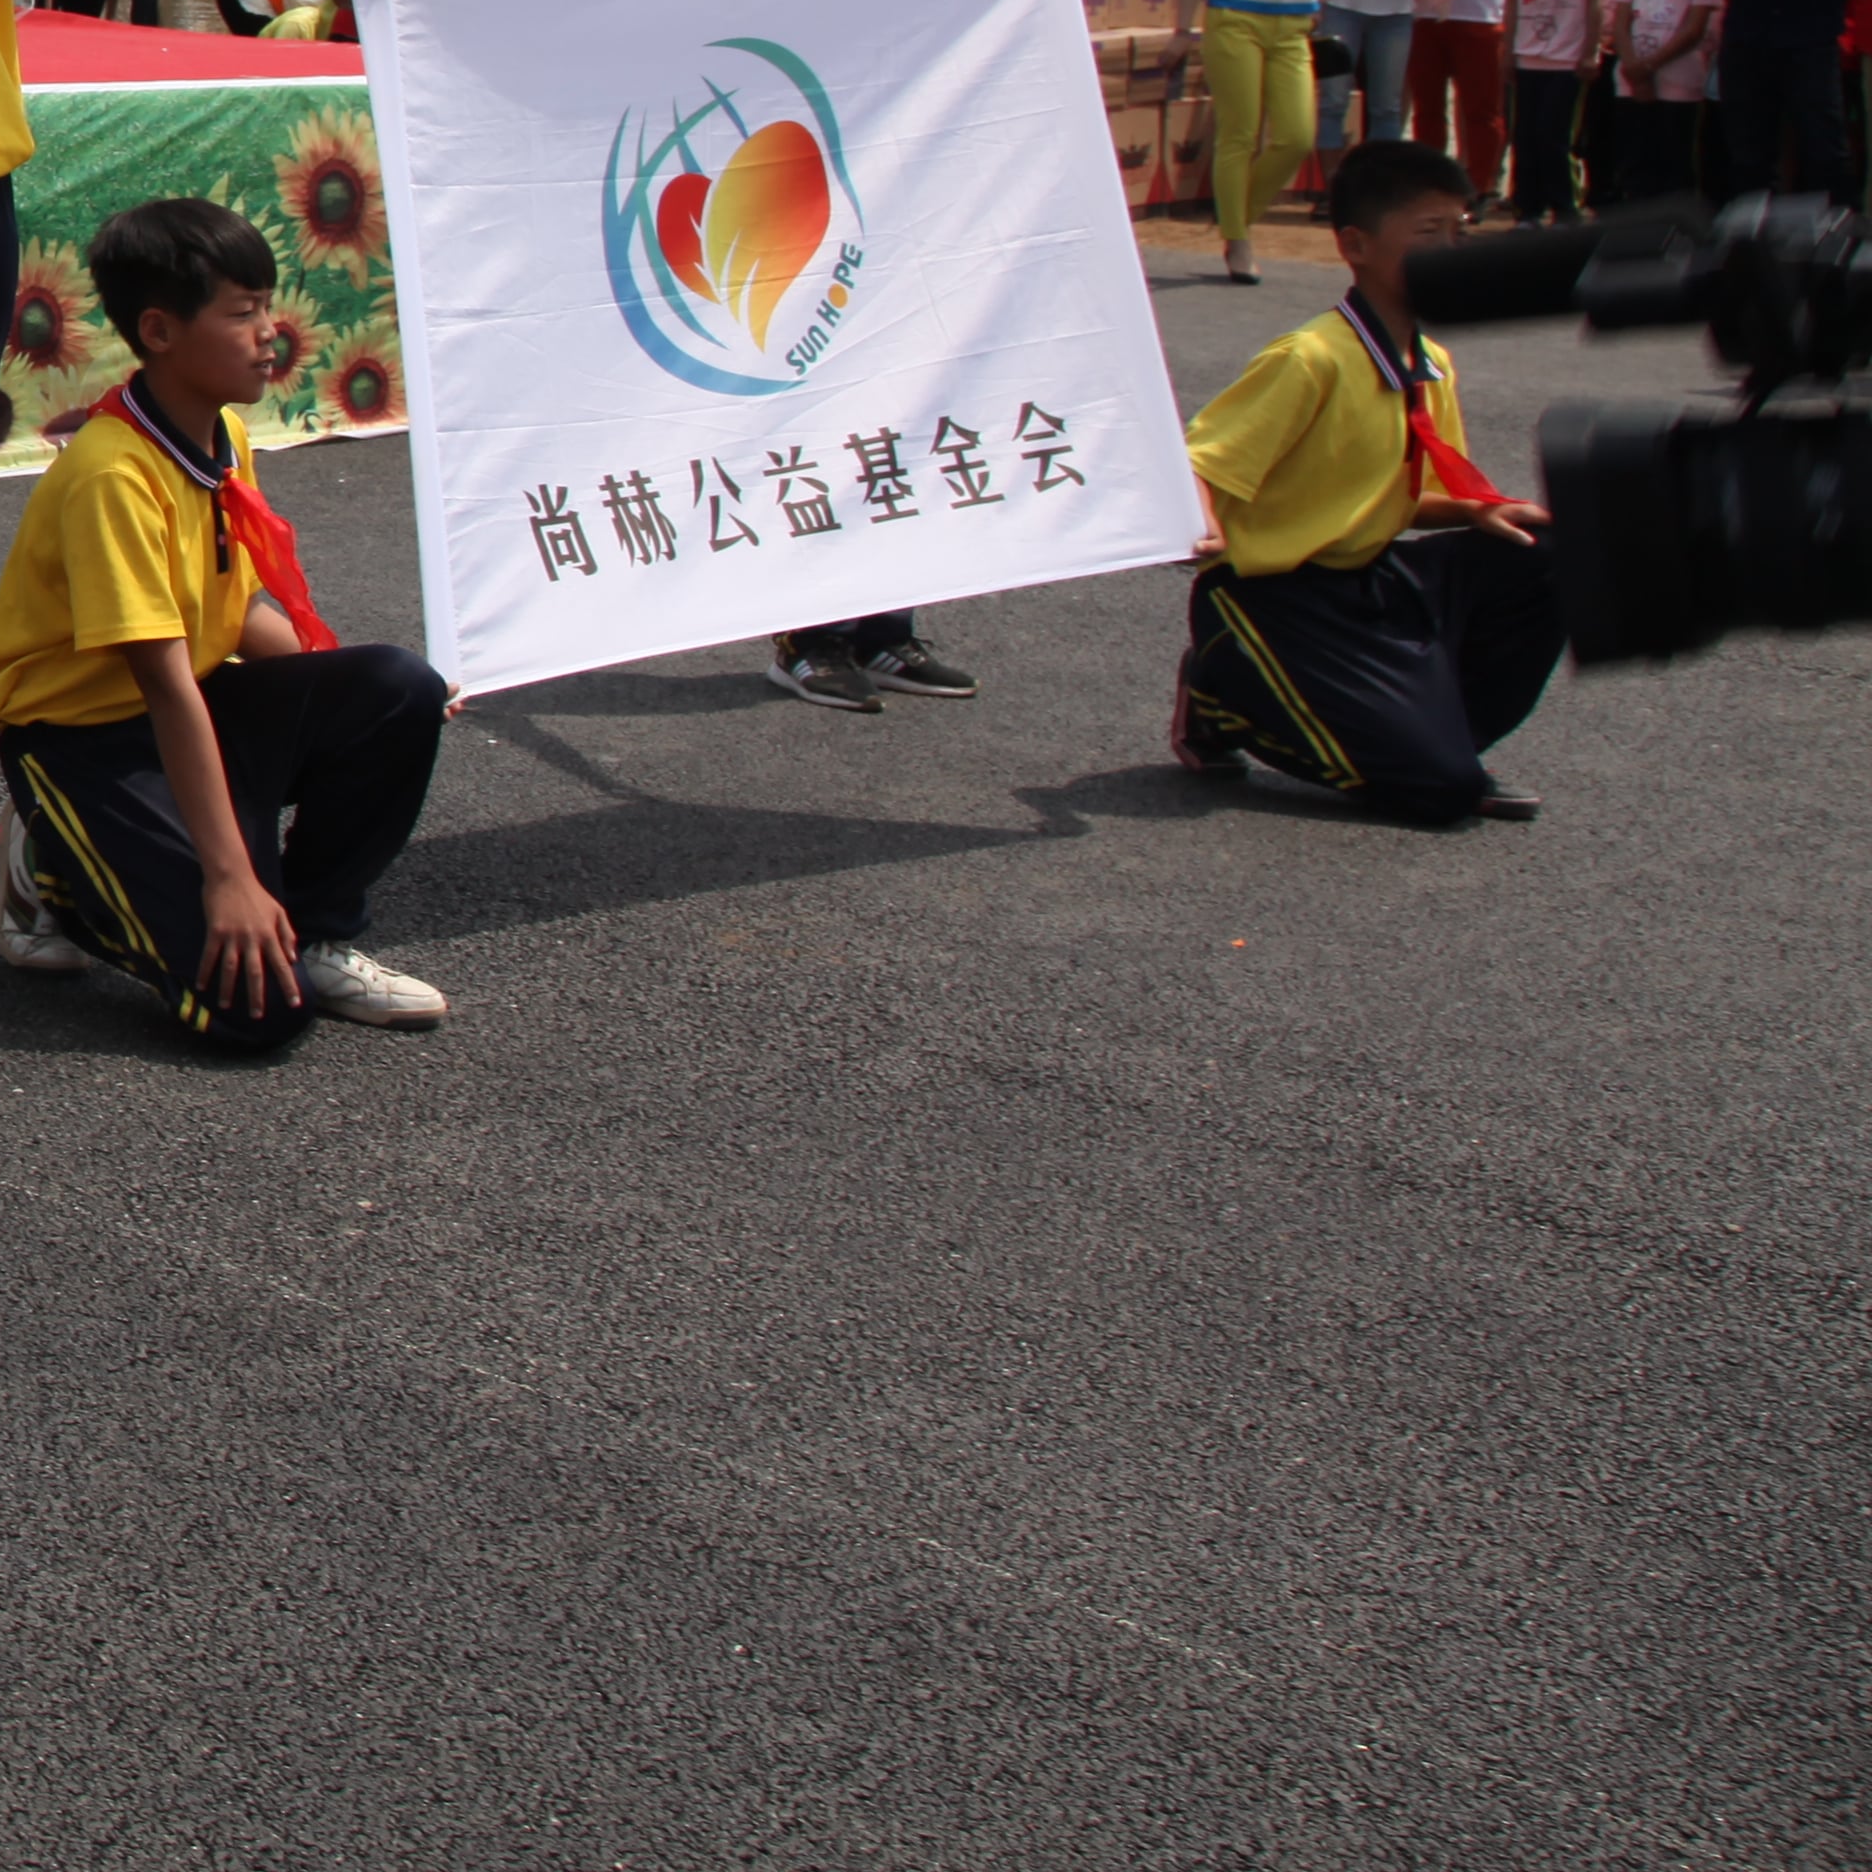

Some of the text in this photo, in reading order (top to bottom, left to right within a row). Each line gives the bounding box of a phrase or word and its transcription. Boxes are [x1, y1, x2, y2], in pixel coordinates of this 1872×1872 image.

[522, 401, 1086, 583] 尚赫公益基金会
